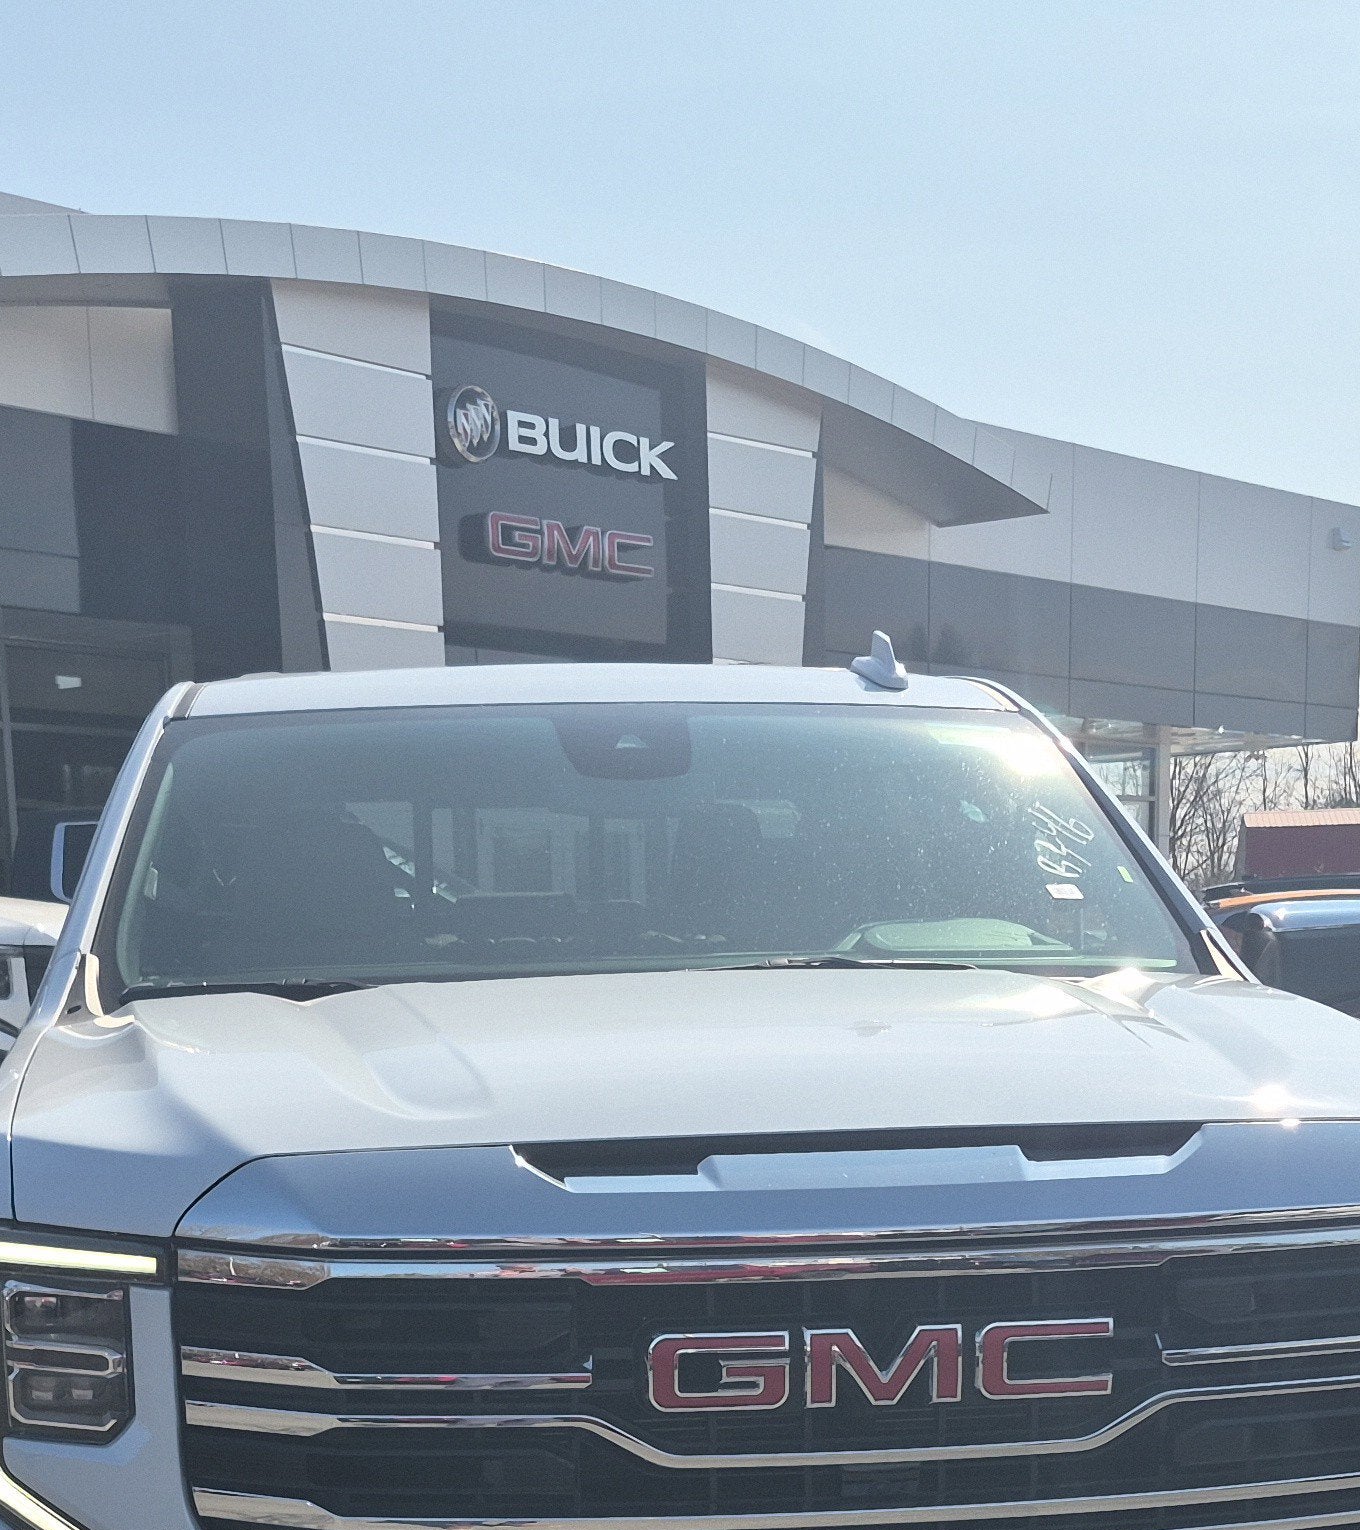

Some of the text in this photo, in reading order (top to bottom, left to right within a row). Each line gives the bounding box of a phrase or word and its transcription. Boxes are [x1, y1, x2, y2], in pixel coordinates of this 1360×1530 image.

[506, 409, 678, 481] BUICK
[488, 510, 654, 577] GMC
[644, 1317, 1114, 1413] GMC
